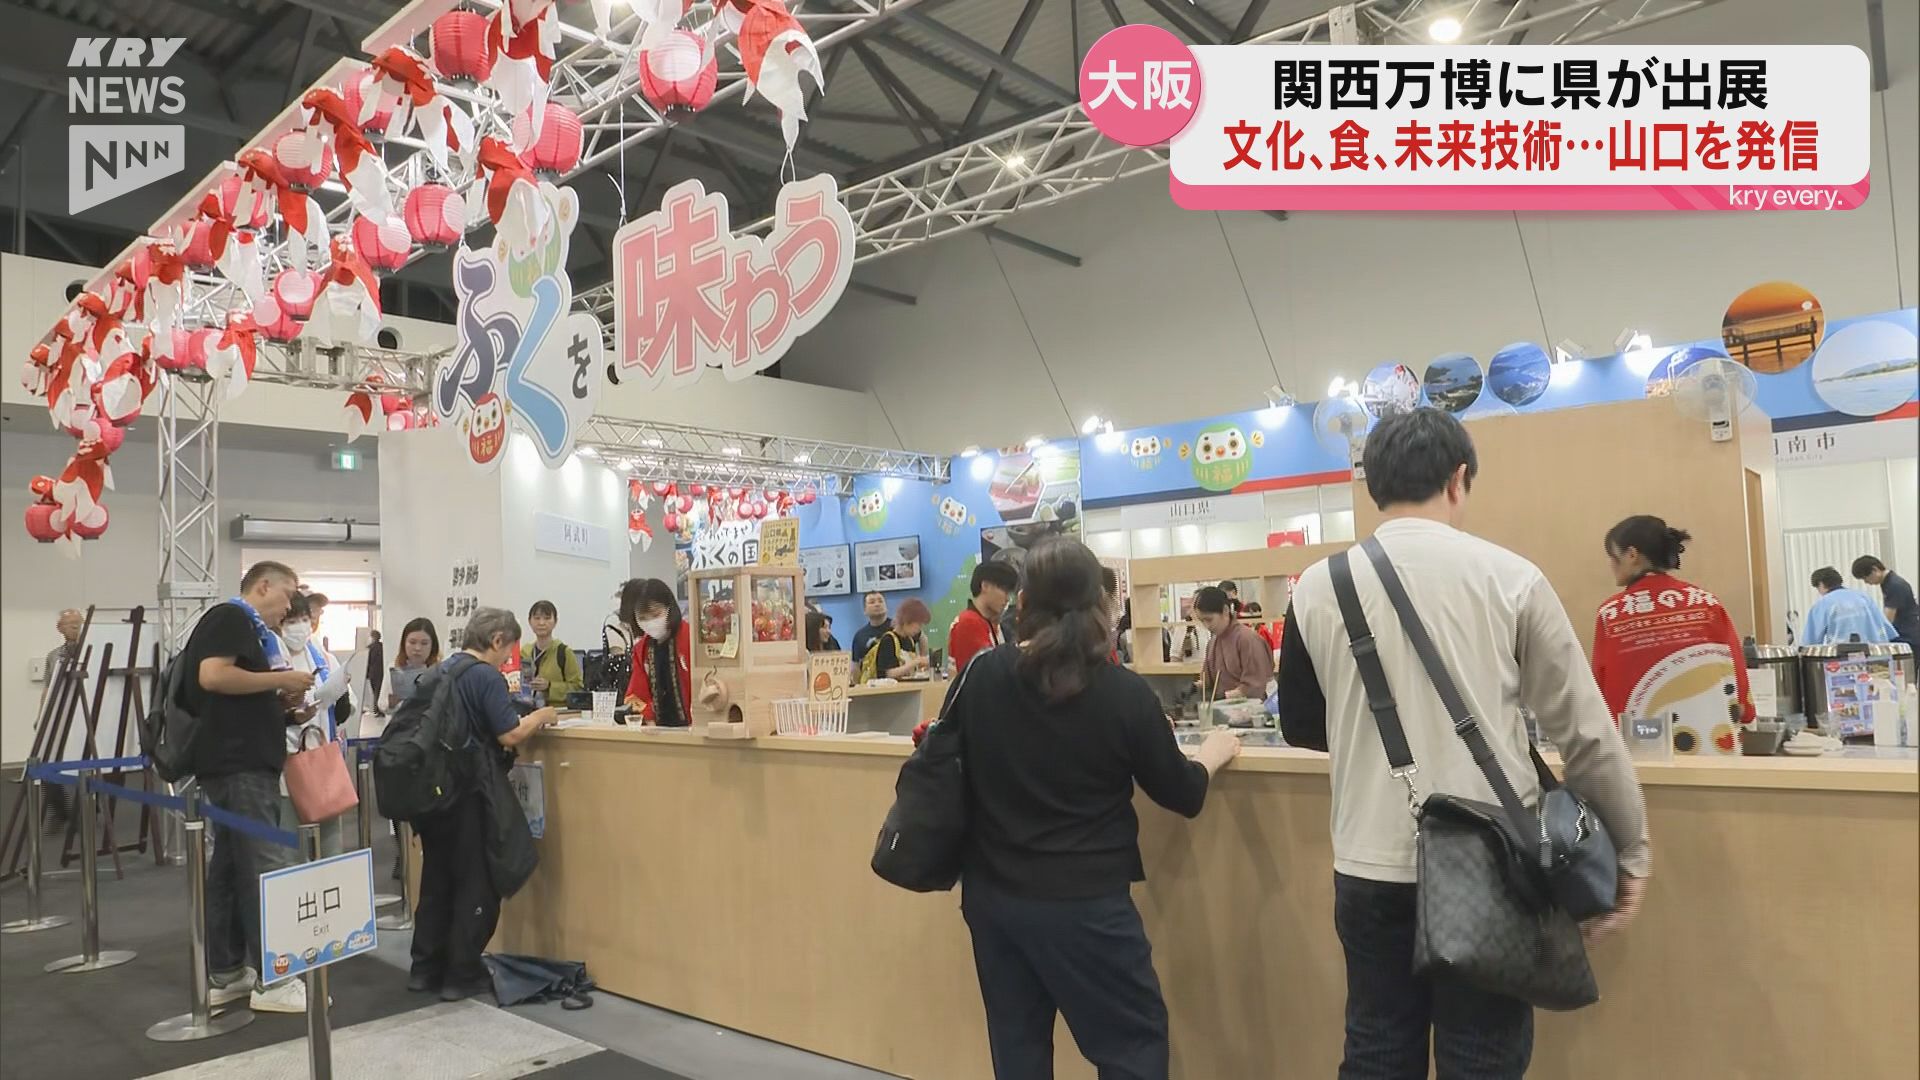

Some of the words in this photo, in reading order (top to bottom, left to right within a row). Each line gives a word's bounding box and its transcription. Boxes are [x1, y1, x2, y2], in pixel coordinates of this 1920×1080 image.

[619, 191, 841, 378] 味わう
[1775, 432, 1836, 455] 南市
[1212, 464, 1233, 483] 福
[298, 886, 341, 923] 出口
[313, 924, 330, 937] Exit
